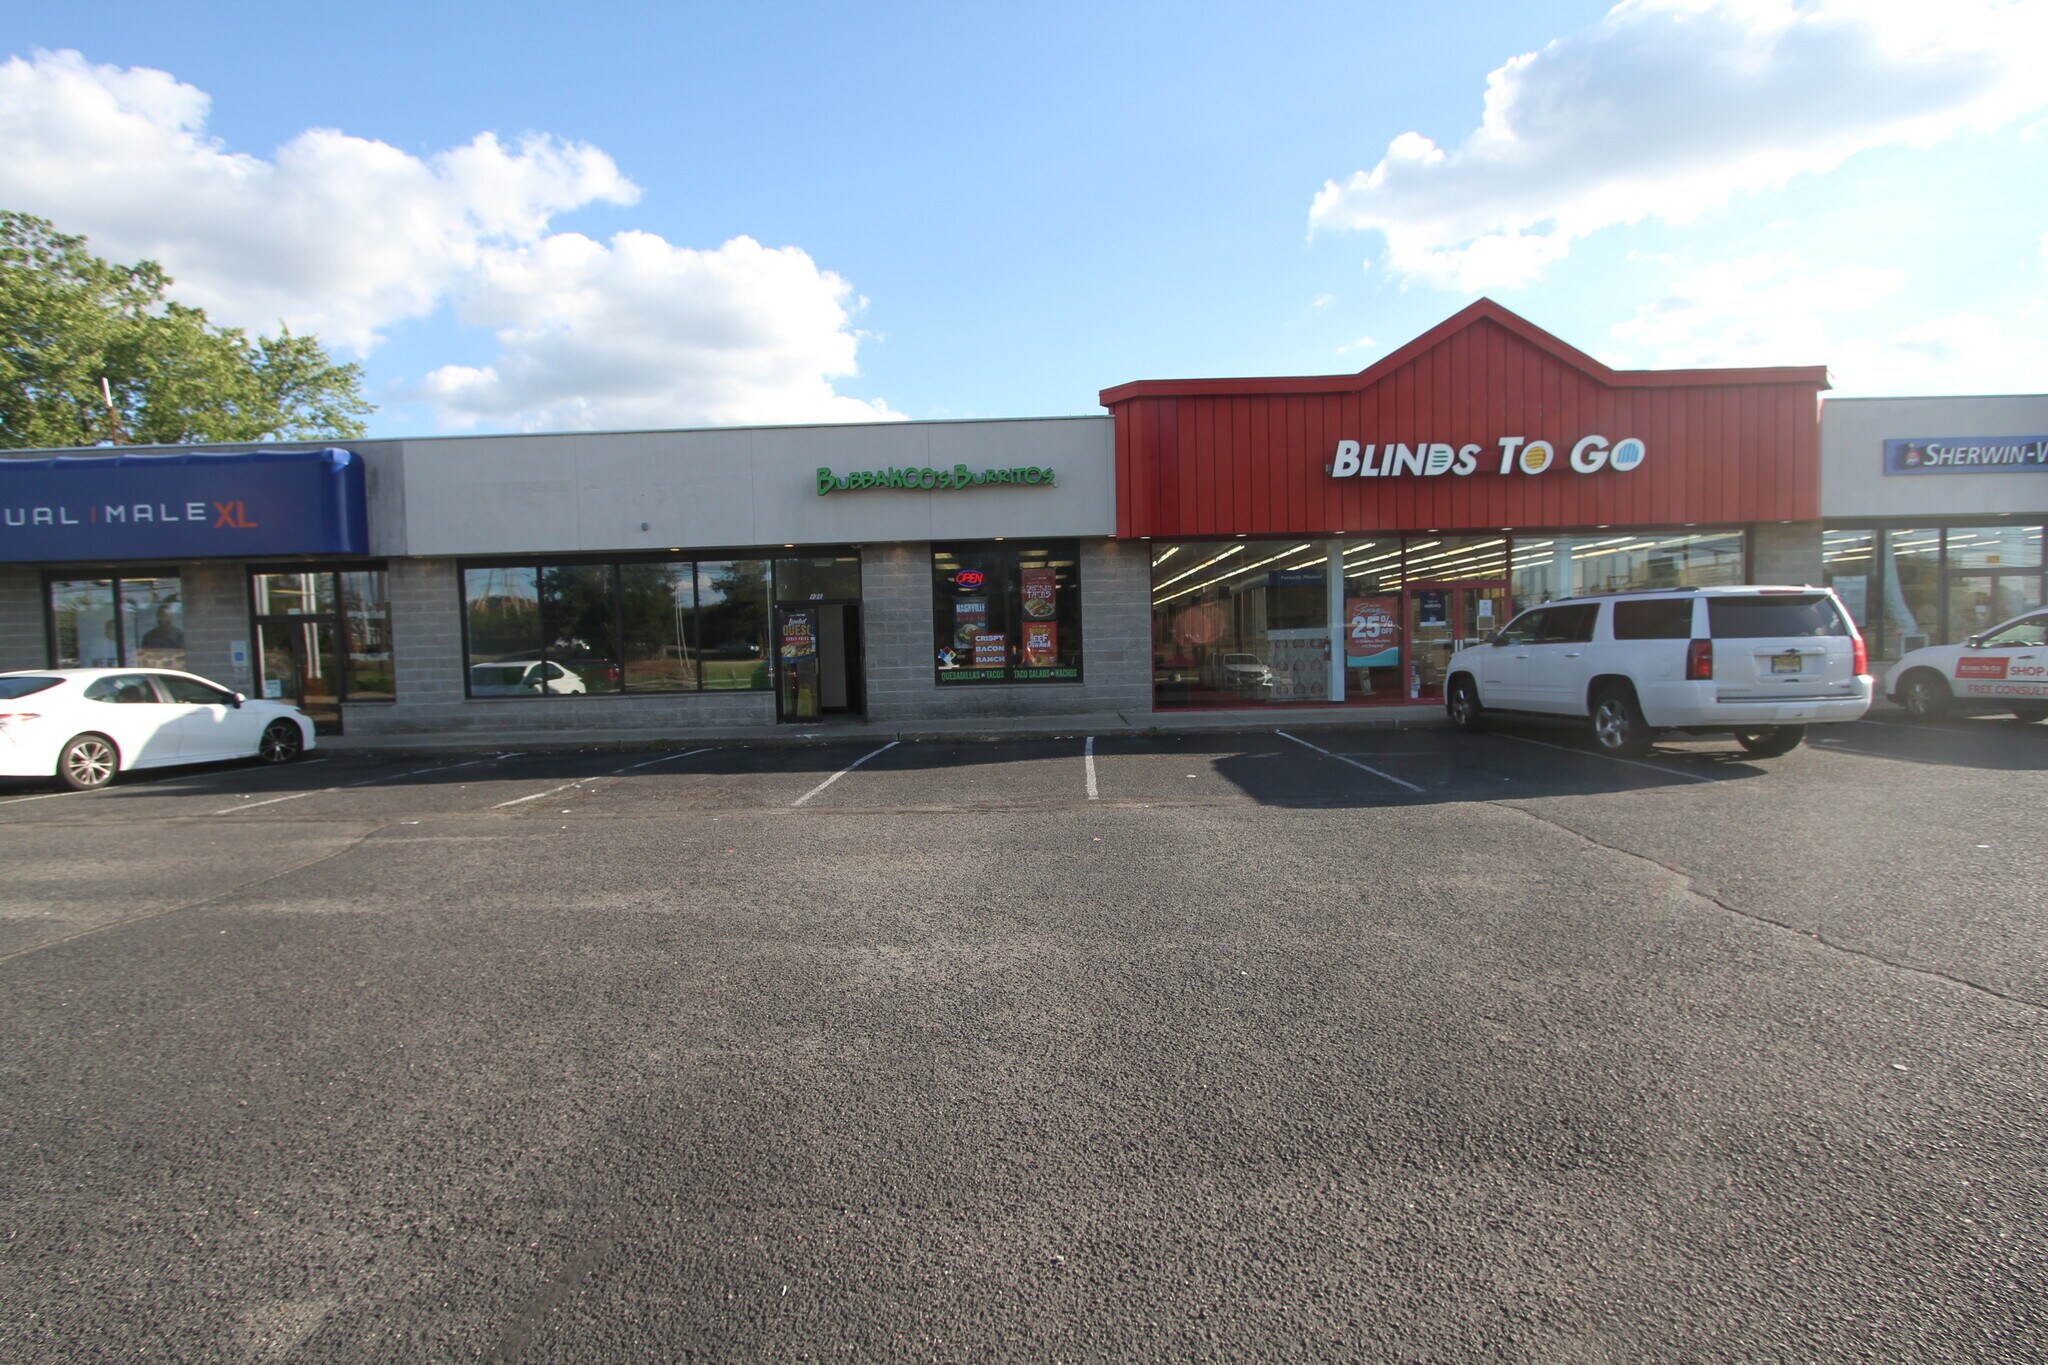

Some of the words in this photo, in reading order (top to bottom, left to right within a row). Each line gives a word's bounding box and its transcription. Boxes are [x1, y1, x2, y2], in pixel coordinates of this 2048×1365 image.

[1332, 440, 1482, 478] BLINDS
[1498, 436, 1554, 475] TO
[1570, 434, 1647, 474] GO
[105, 502, 207, 523] MALE
[213, 501, 259, 528] XL
[956, 573, 983, 583] OPEN
[956, 603, 985, 613] NASHVILLE
[985, 669, 1005, 680] TACOS
[1013, 670, 1028, 679] TACO
[2010, 666, 2044, 676] SHOP
[1967, 684, 1993, 693] FREE
